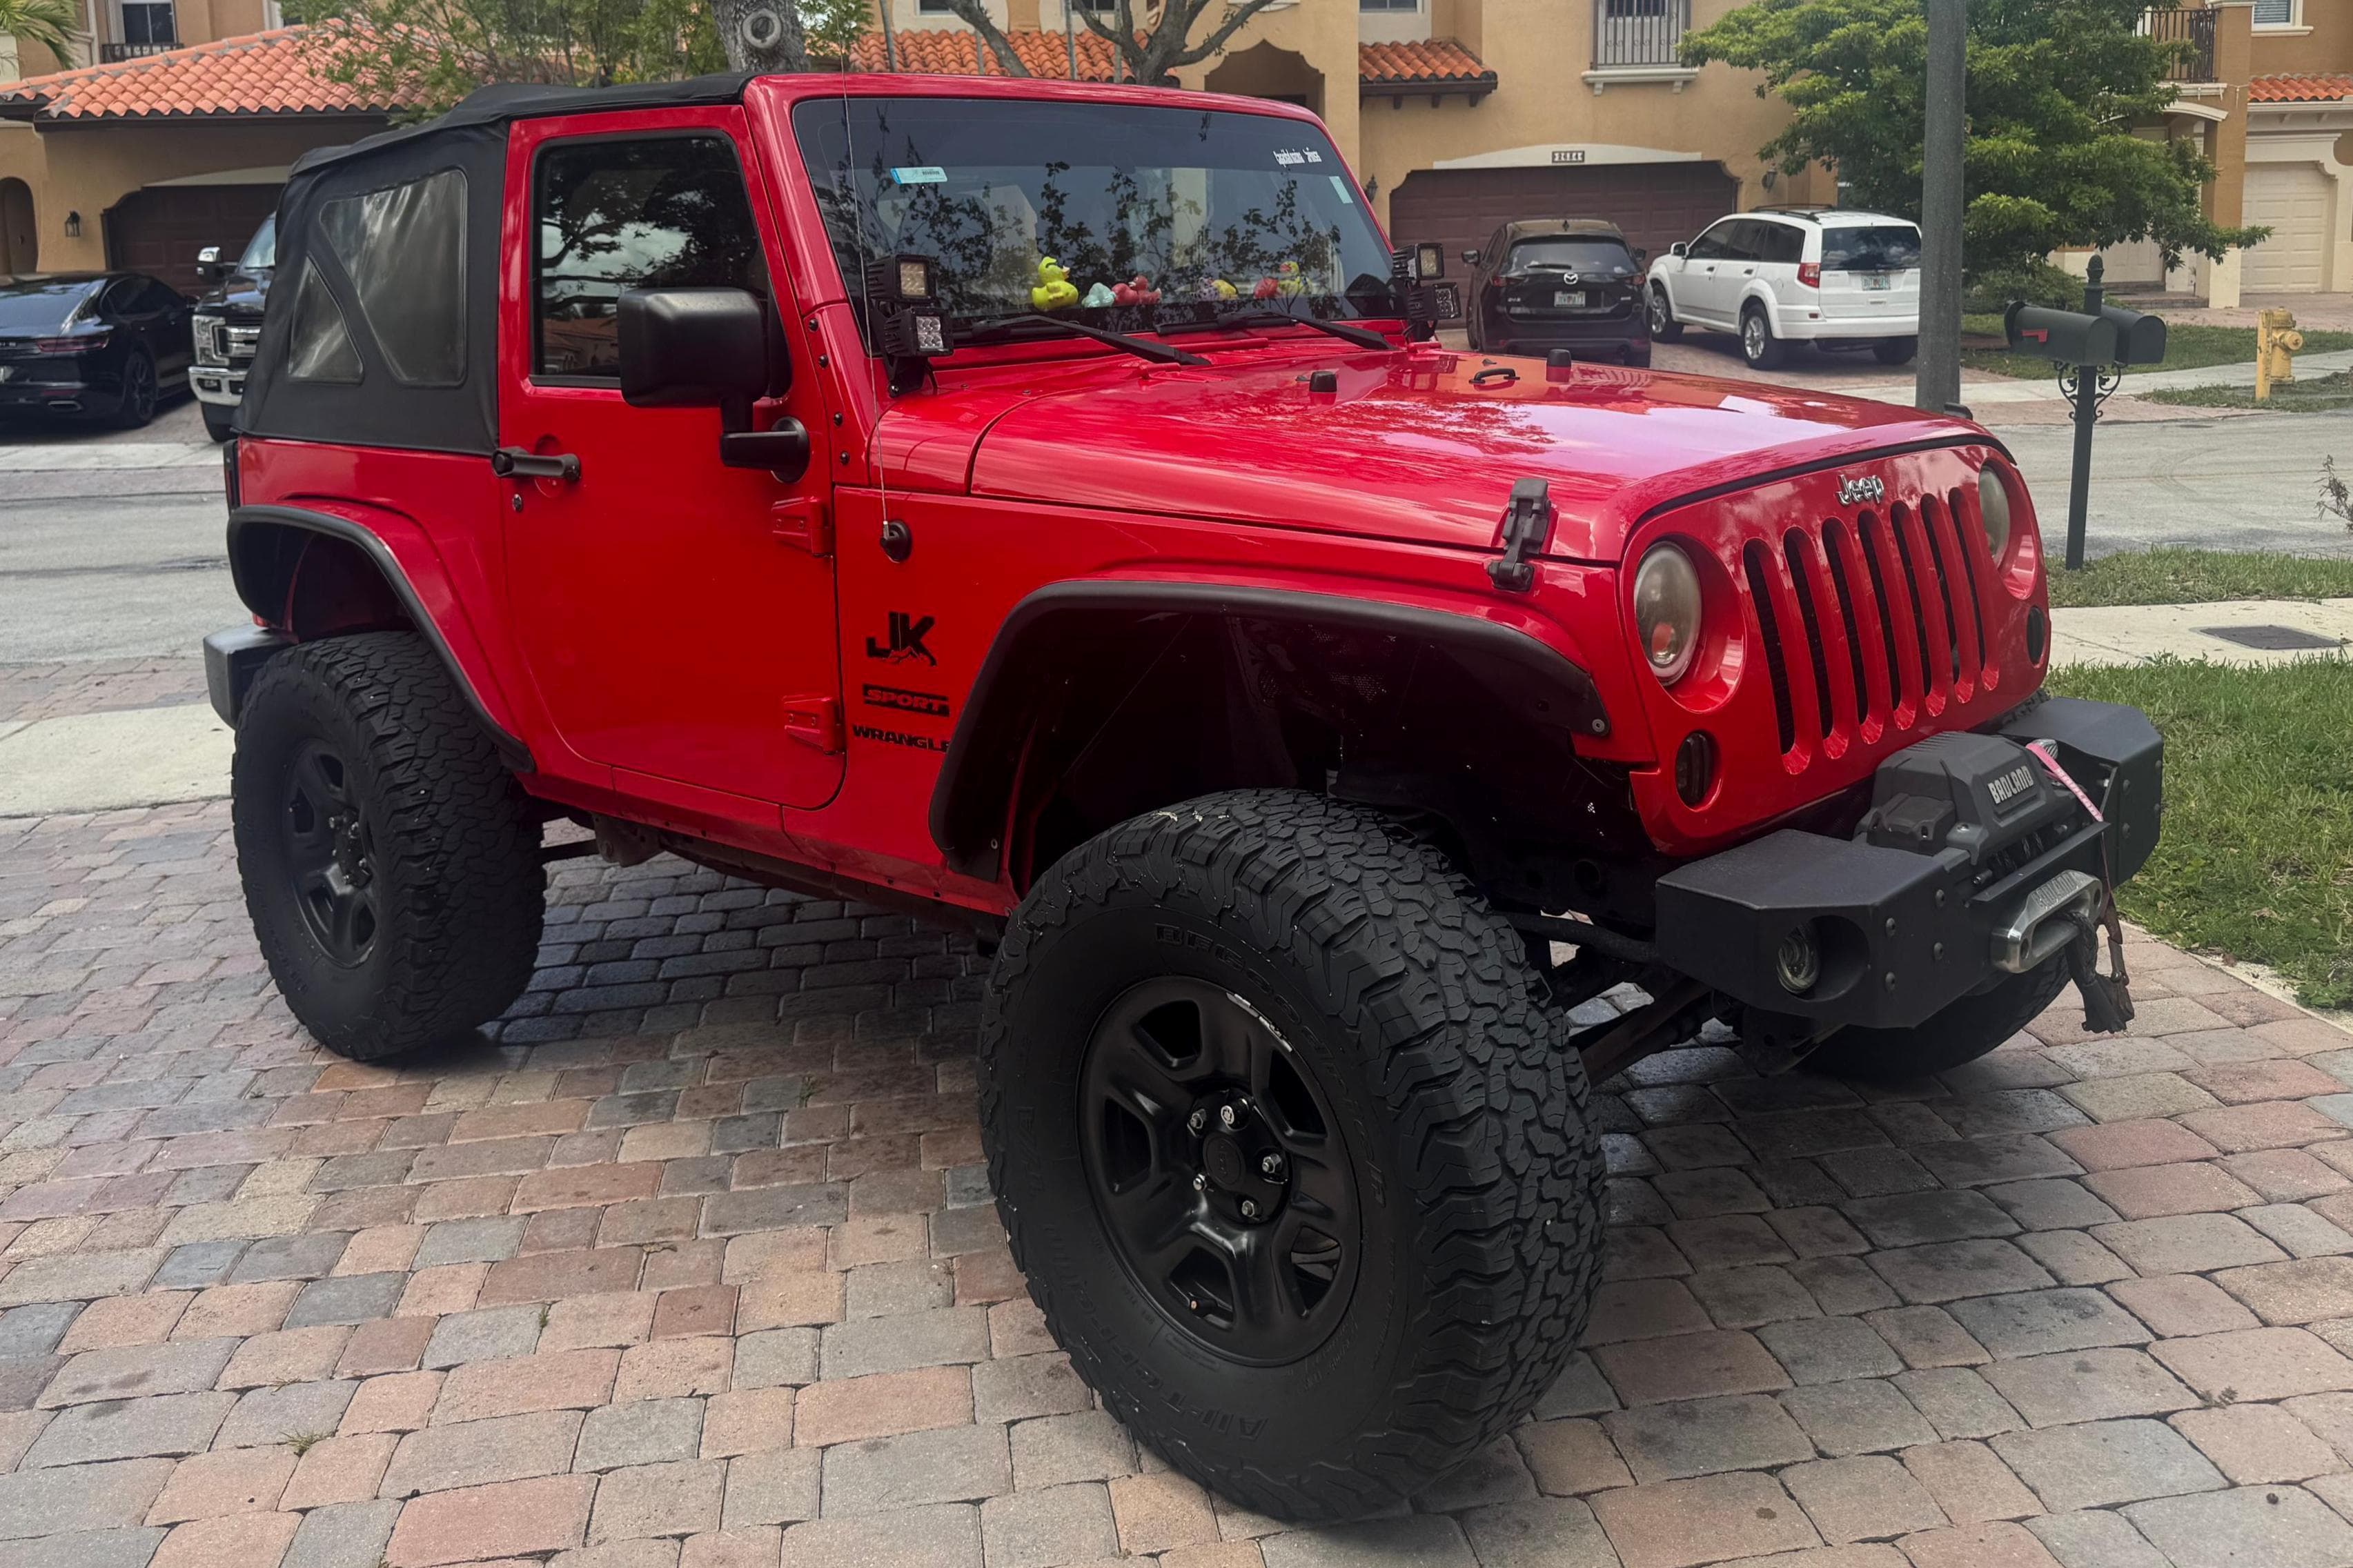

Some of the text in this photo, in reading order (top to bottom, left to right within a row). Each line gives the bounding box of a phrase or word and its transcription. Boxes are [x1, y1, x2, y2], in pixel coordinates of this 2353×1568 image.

[1835, 474, 1884, 506] Jeep
[866, 688, 947, 713] SPORT
[852, 724, 950, 753] WRANGLE
[1987, 766, 2034, 805] BADLAND
